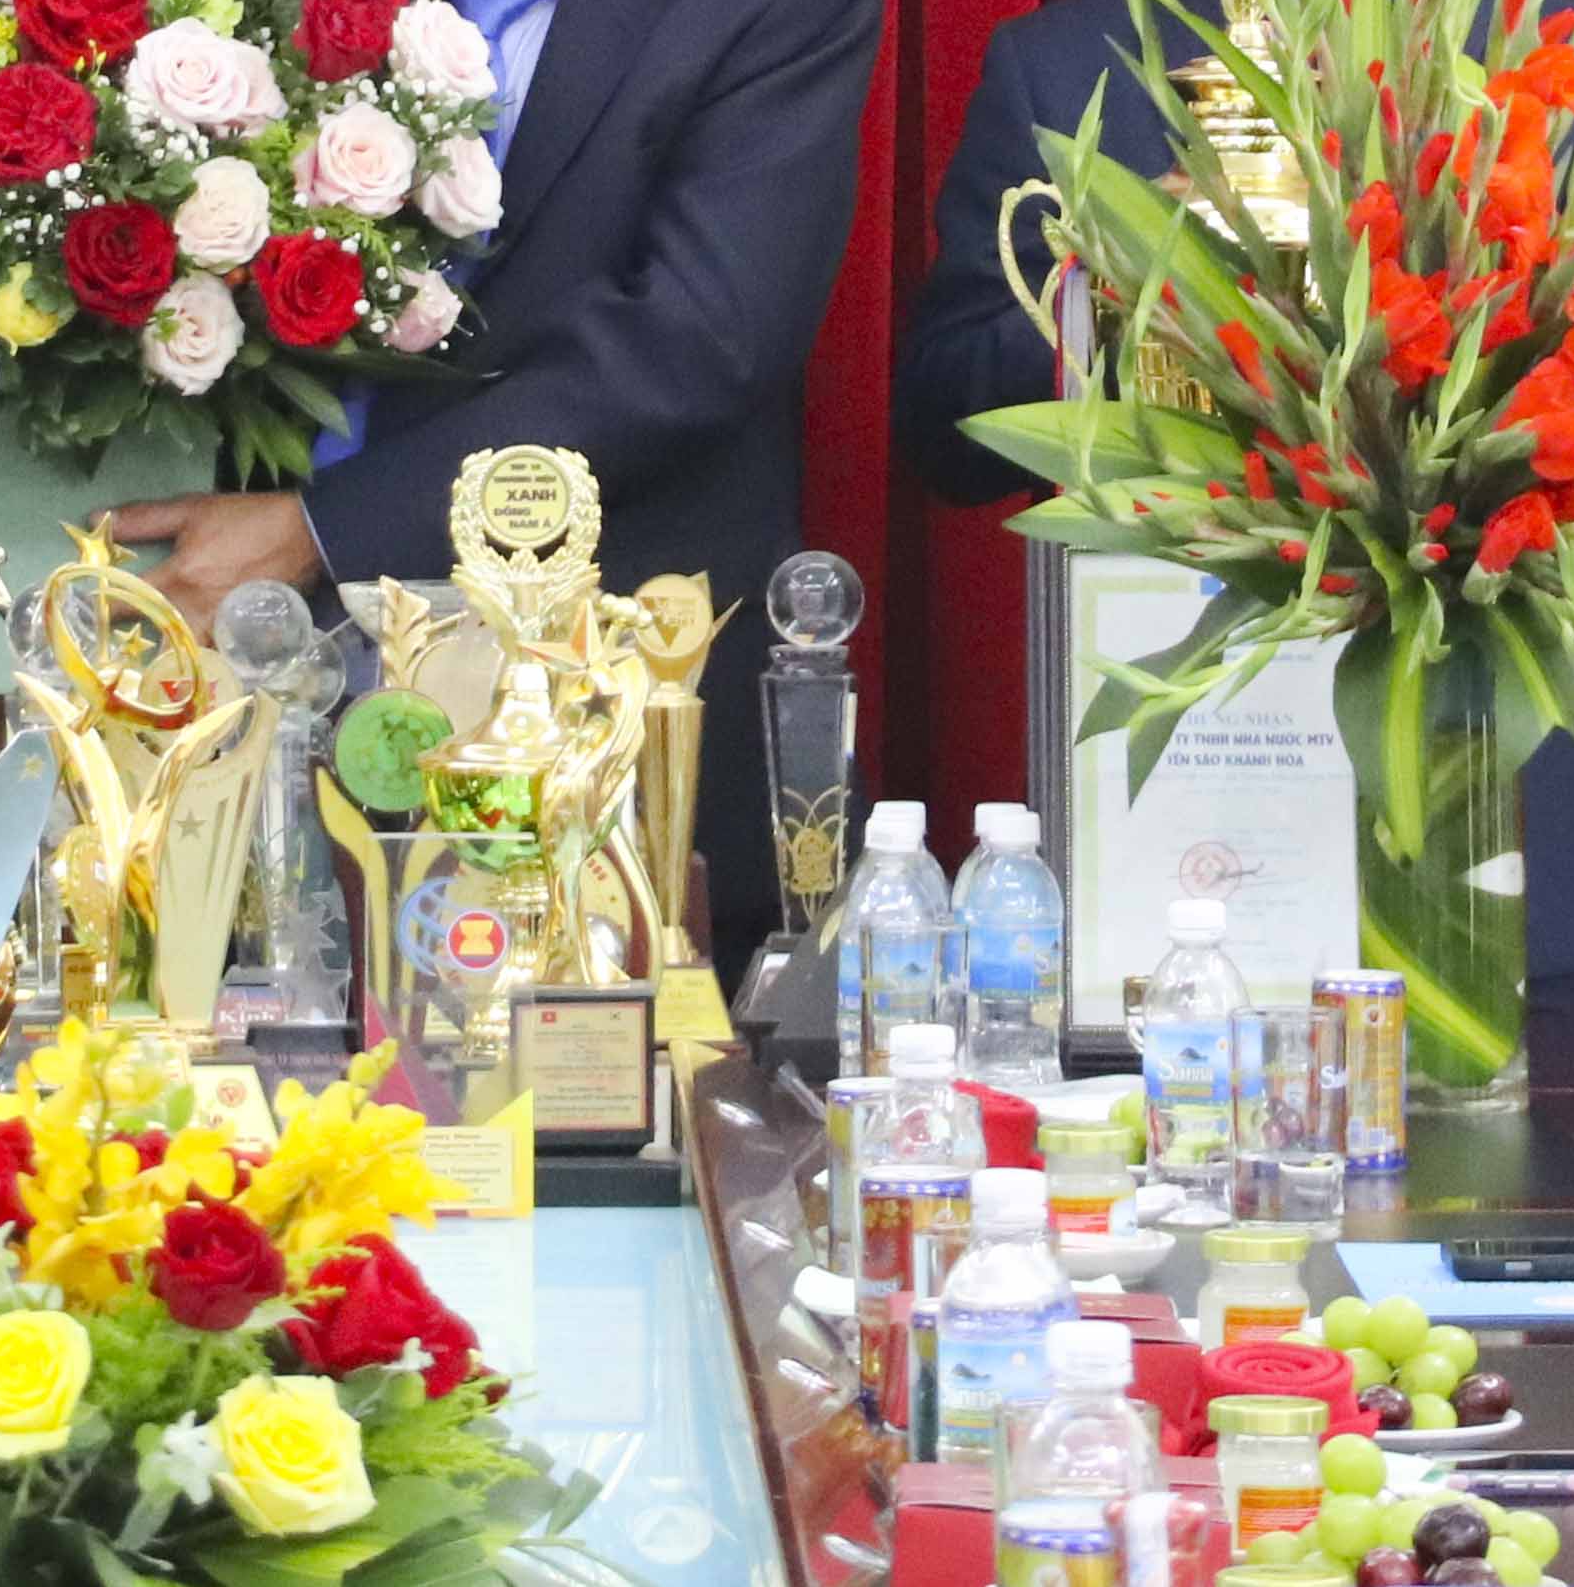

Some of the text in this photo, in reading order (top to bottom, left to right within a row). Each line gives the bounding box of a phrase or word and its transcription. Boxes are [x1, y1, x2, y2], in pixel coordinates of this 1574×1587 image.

[506, 489, 557, 502] XANH
[509, 519, 539, 530] NAM
[1194, 733, 1230, 746] TNHH
[1307, 733, 1335, 746] MTV
